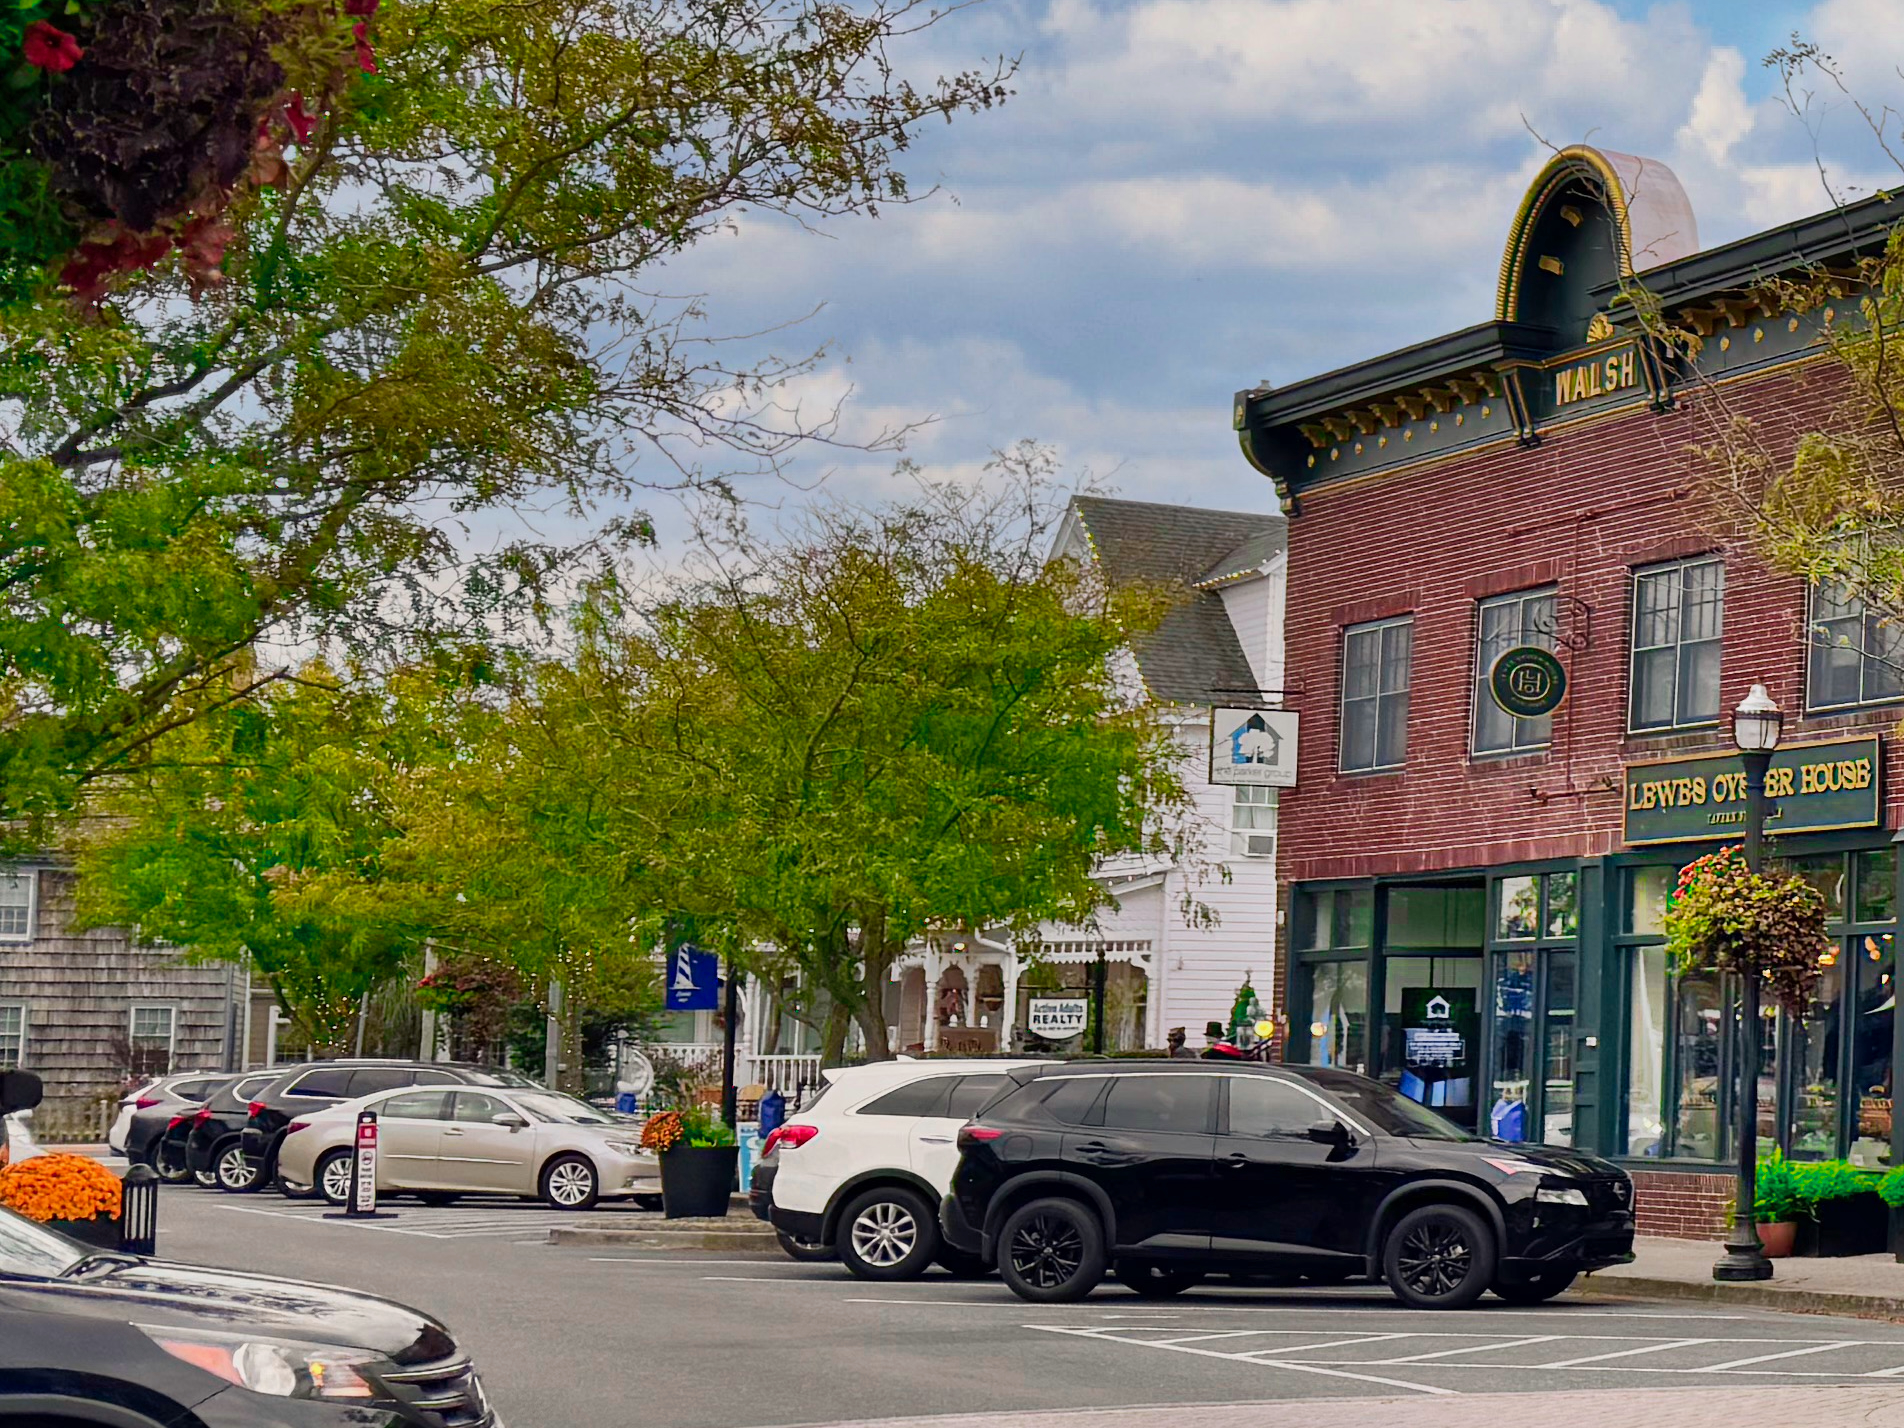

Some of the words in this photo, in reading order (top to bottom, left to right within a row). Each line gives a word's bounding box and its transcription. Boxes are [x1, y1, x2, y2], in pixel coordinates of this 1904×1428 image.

[1556, 352, 1637, 406] WALSH
[1630, 777, 1707, 810] LEWES
[1713, 767, 1795, 803] OYSER
[1800, 758, 1872, 794] HOUSE
[1033, 1015, 1083, 1024] REALTY
